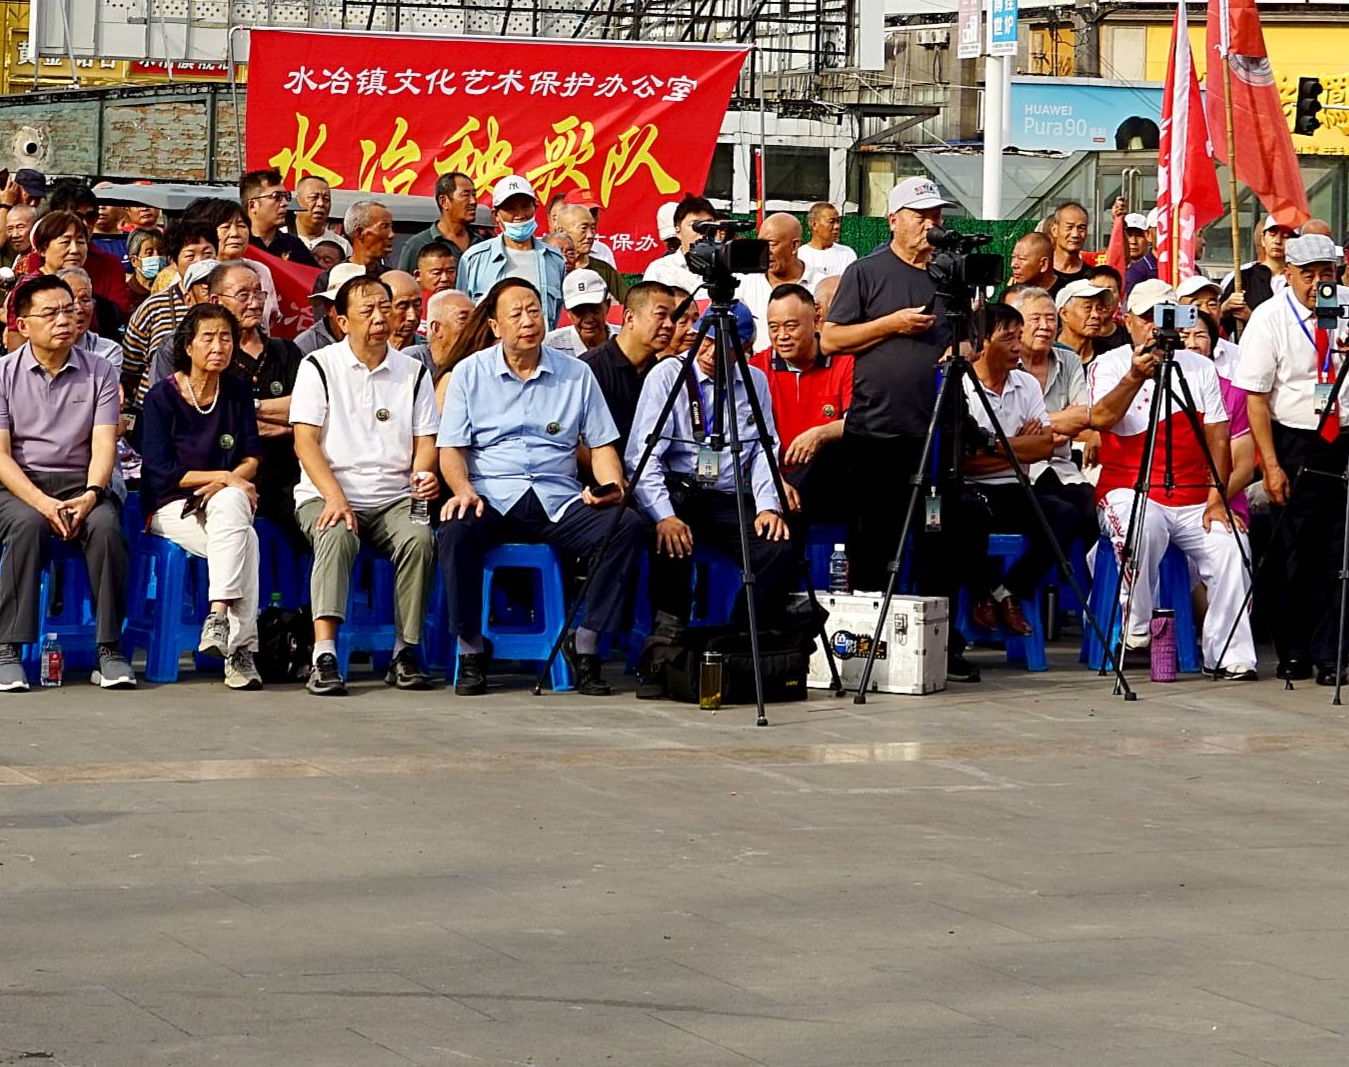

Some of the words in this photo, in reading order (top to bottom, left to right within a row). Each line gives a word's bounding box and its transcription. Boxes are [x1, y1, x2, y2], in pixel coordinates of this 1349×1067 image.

[284, 65, 698, 102] 水冶镇文化艺术保护办公室
[1024, 104, 1073, 116] HUAWEI
[268, 112, 681, 209] 水冶秧歌队
[692, 401, 700, 424] Canon
